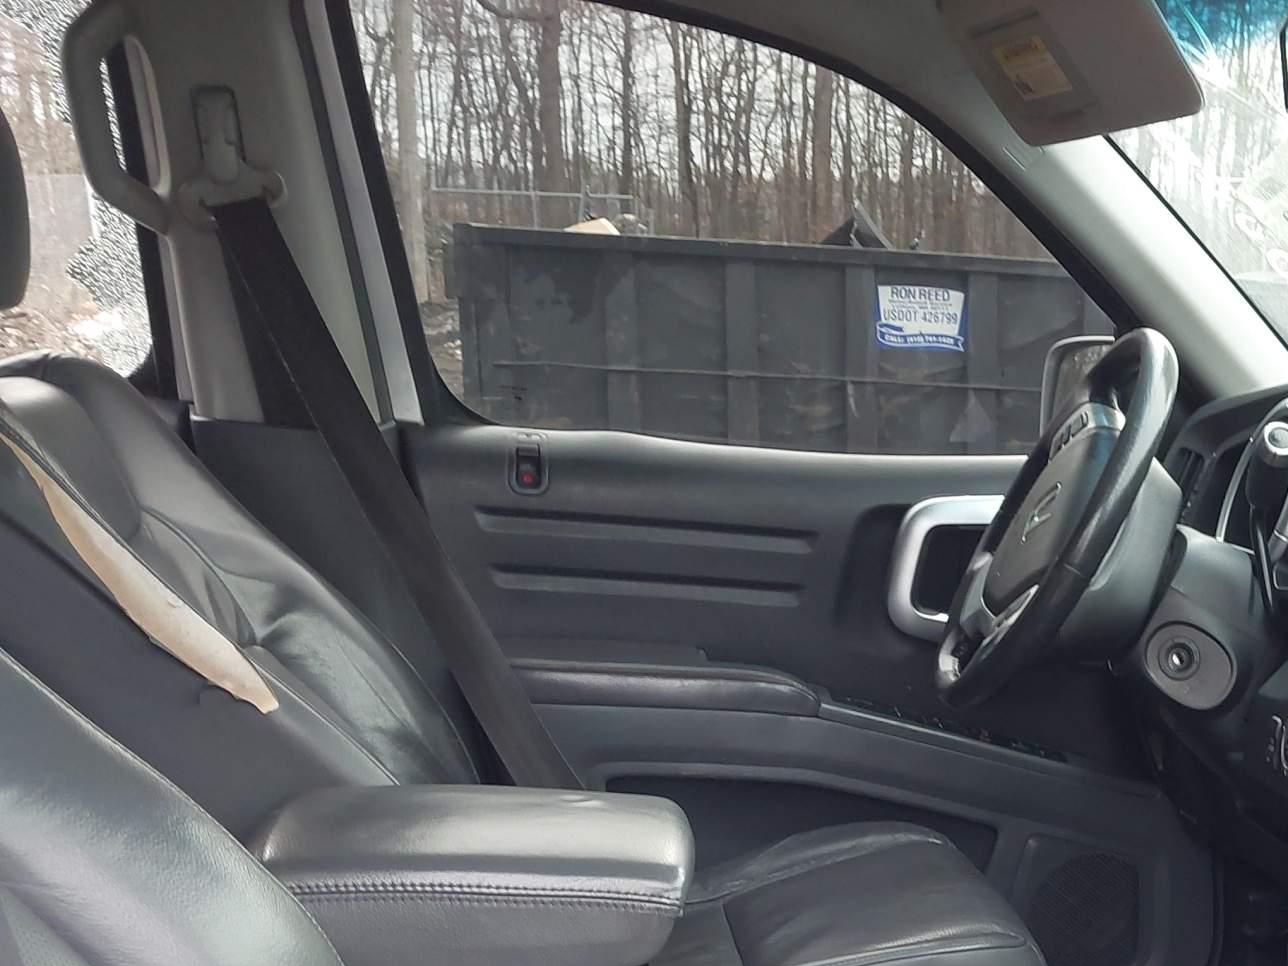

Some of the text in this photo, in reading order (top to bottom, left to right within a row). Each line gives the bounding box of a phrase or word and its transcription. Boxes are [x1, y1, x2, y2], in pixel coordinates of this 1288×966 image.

[891, 287, 951, 302] RON REED
[884, 309, 958, 324] USDOT 426799
